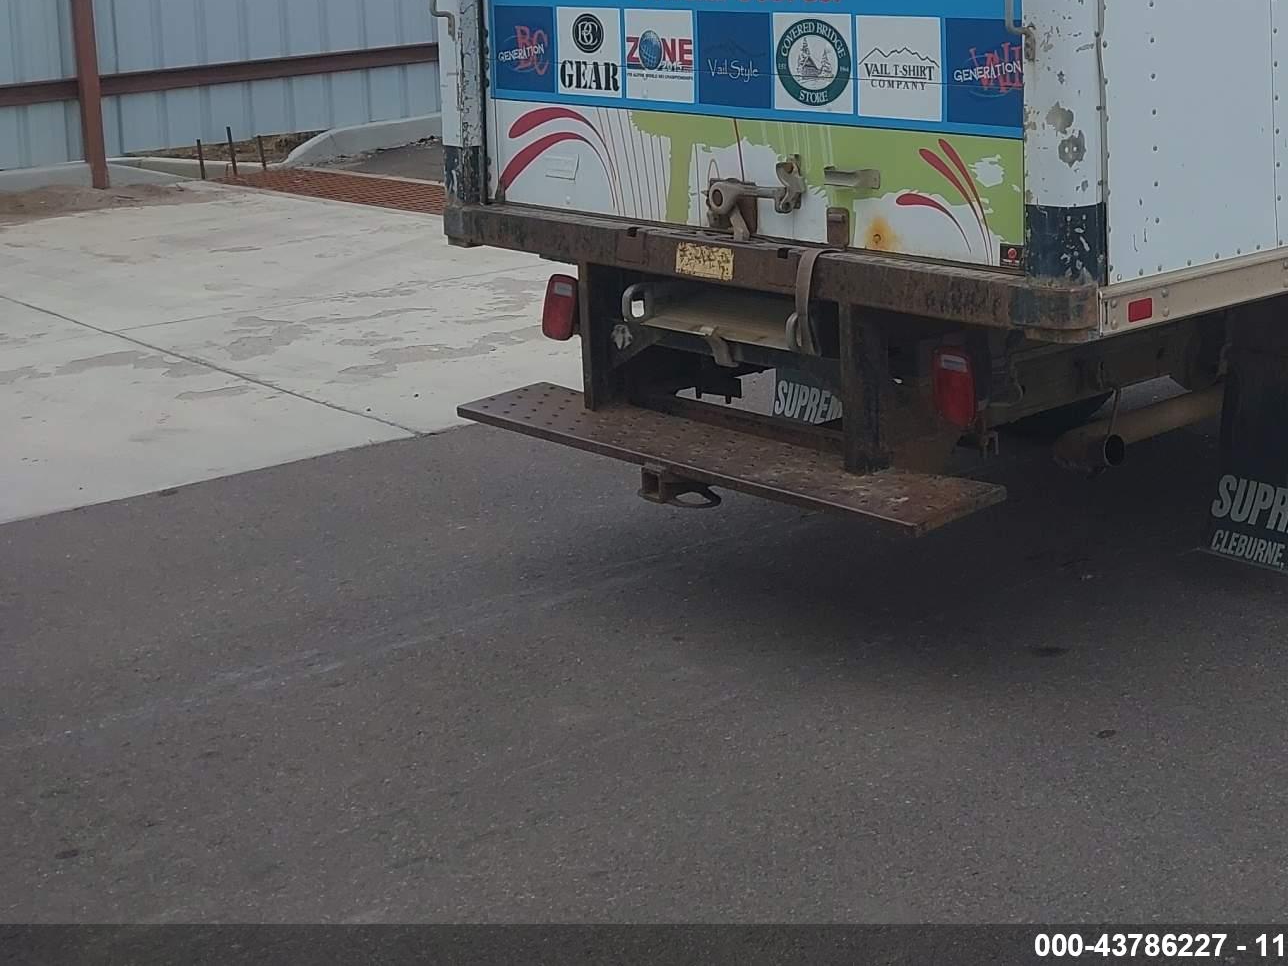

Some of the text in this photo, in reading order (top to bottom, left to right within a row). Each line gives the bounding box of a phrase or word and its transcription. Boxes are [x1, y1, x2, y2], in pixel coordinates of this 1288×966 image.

[626, 31, 693, 70] ZONE
[781, 22, 846, 59] COVERED BRIDGE
[498, 43, 545, 62] GENERATION
[560, 60, 620, 91] GEAR
[708, 59, 760, 82] Vail Style
[864, 63, 891, 78] VAIL
[894, 64, 935, 81] T-SHIRT
[954, 60, 1022, 82] GENERATION
[871, 79, 928, 91] COMPANY
[800, 90, 829, 104] STORE
[775, 380, 843, 425] SUPREM
[1211, 529, 1285, 570] CLEBURNE,
